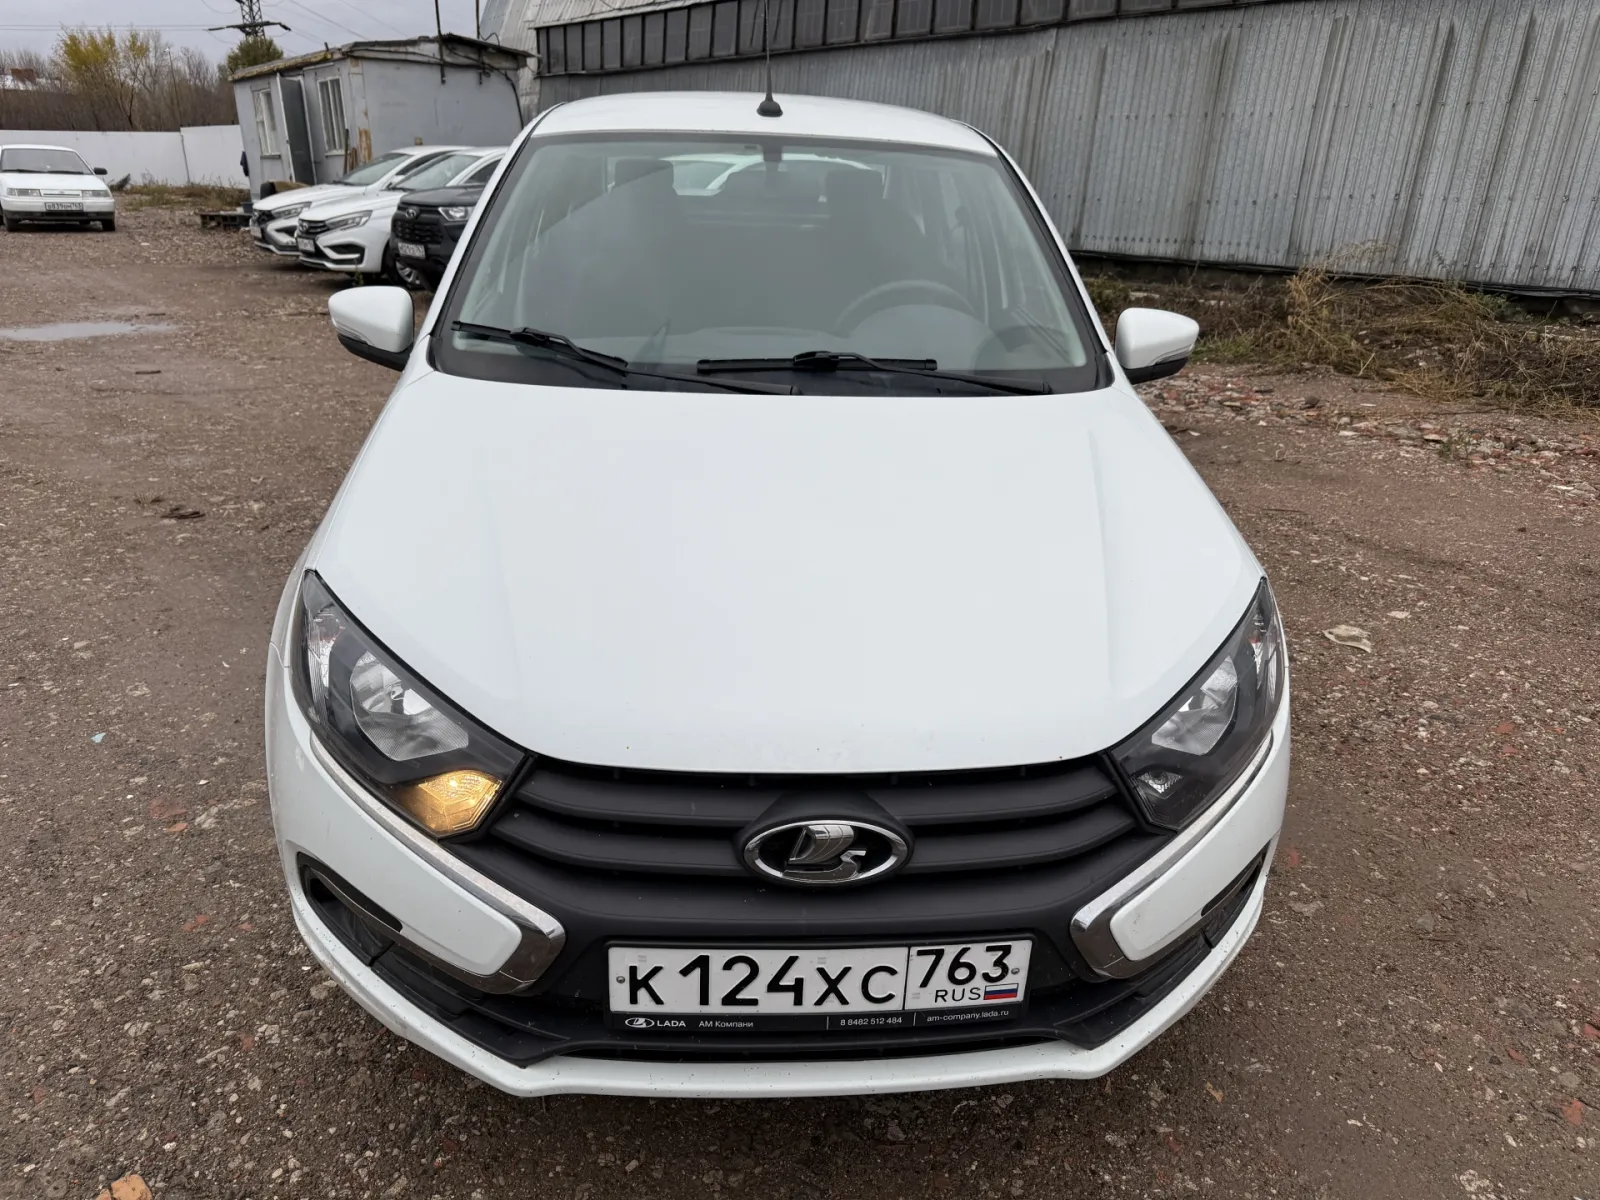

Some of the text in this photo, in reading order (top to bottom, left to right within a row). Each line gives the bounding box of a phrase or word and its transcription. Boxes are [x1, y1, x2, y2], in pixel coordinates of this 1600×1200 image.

[628, 944, 1013, 1007] К124ХС 763
[934, 987, 982, 1004] RUS
[848, 1018, 869, 1026] 8482
[870, 1017, 886, 1025] 512
[886, 1016, 902, 1025] 484
[926, 1009, 1009, 1023] am-company.lada.ru
[656, 1020, 687, 1028] LADA
[715, 1020, 754, 1029] Компани
